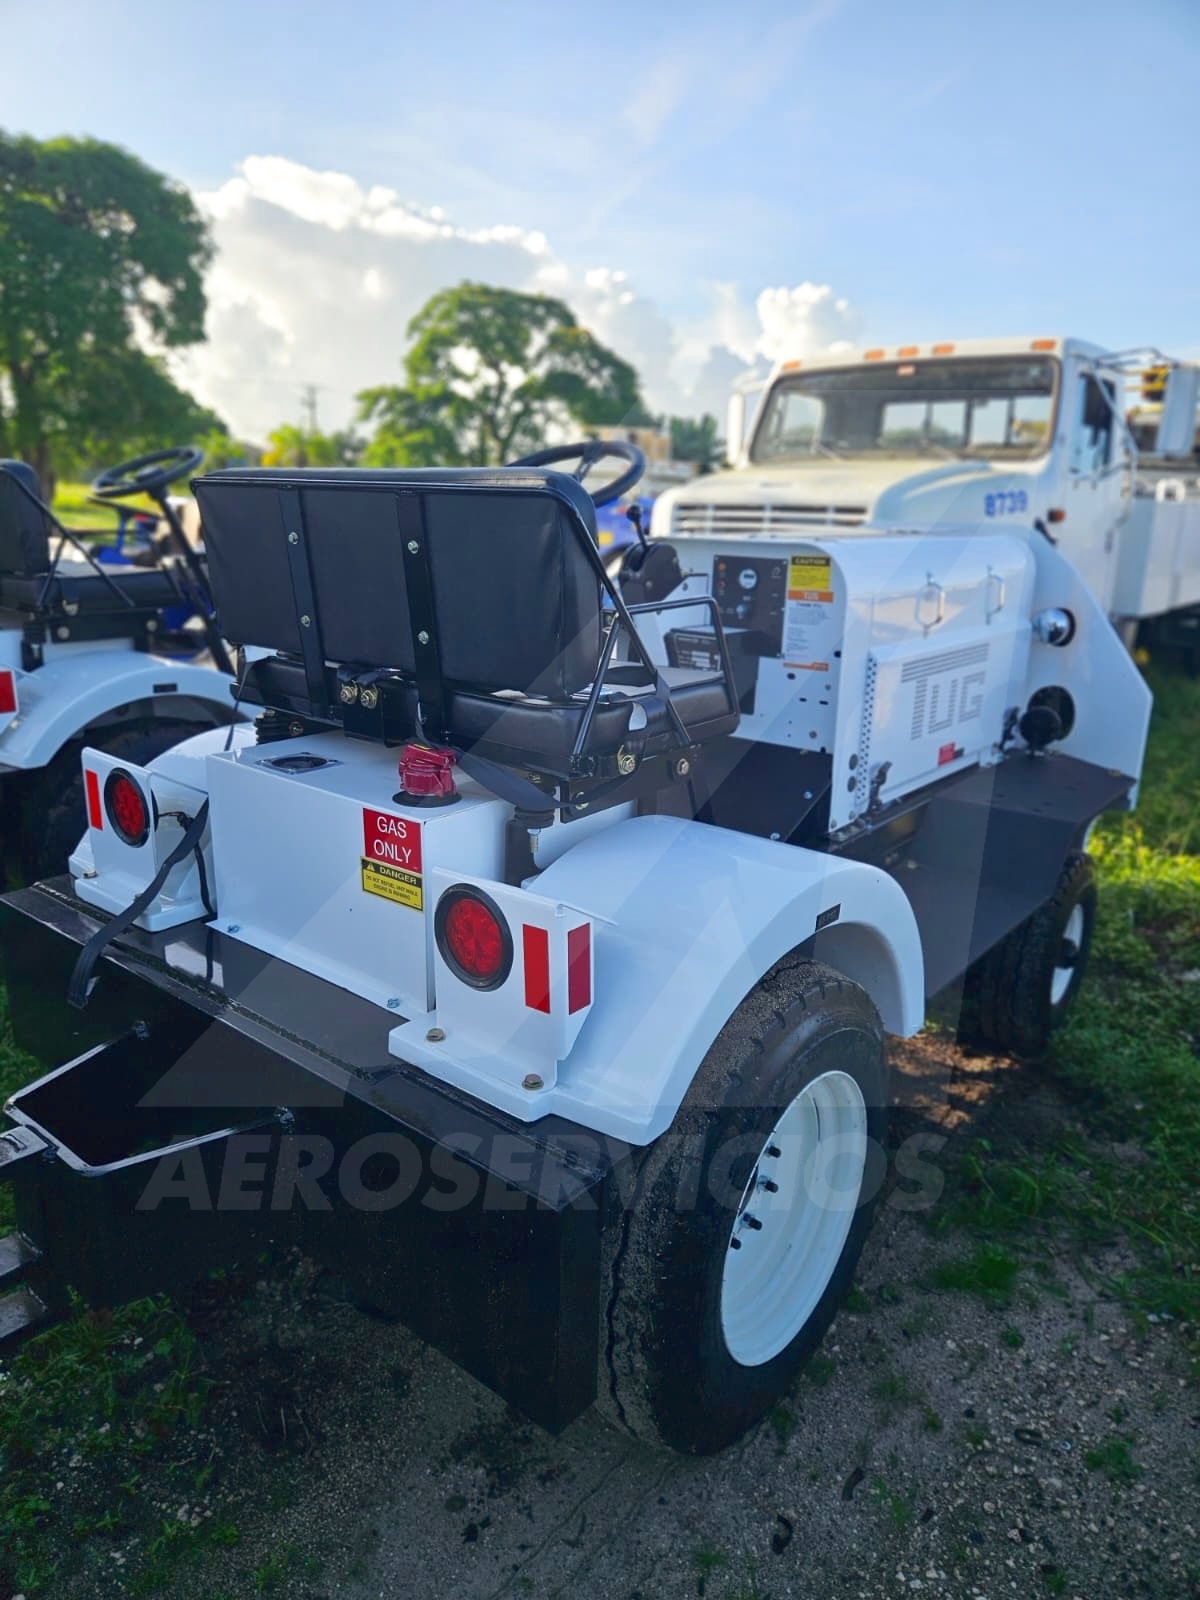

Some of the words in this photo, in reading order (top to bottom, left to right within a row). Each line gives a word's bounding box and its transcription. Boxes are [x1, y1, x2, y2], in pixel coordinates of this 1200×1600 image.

[985, 491, 1027, 517] 8739
[901, 642, 989, 740] TUG
[377, 816, 407, 838] GAS
[374, 840, 412, 863] ONLY
[379, 866, 417, 885] DANGER
